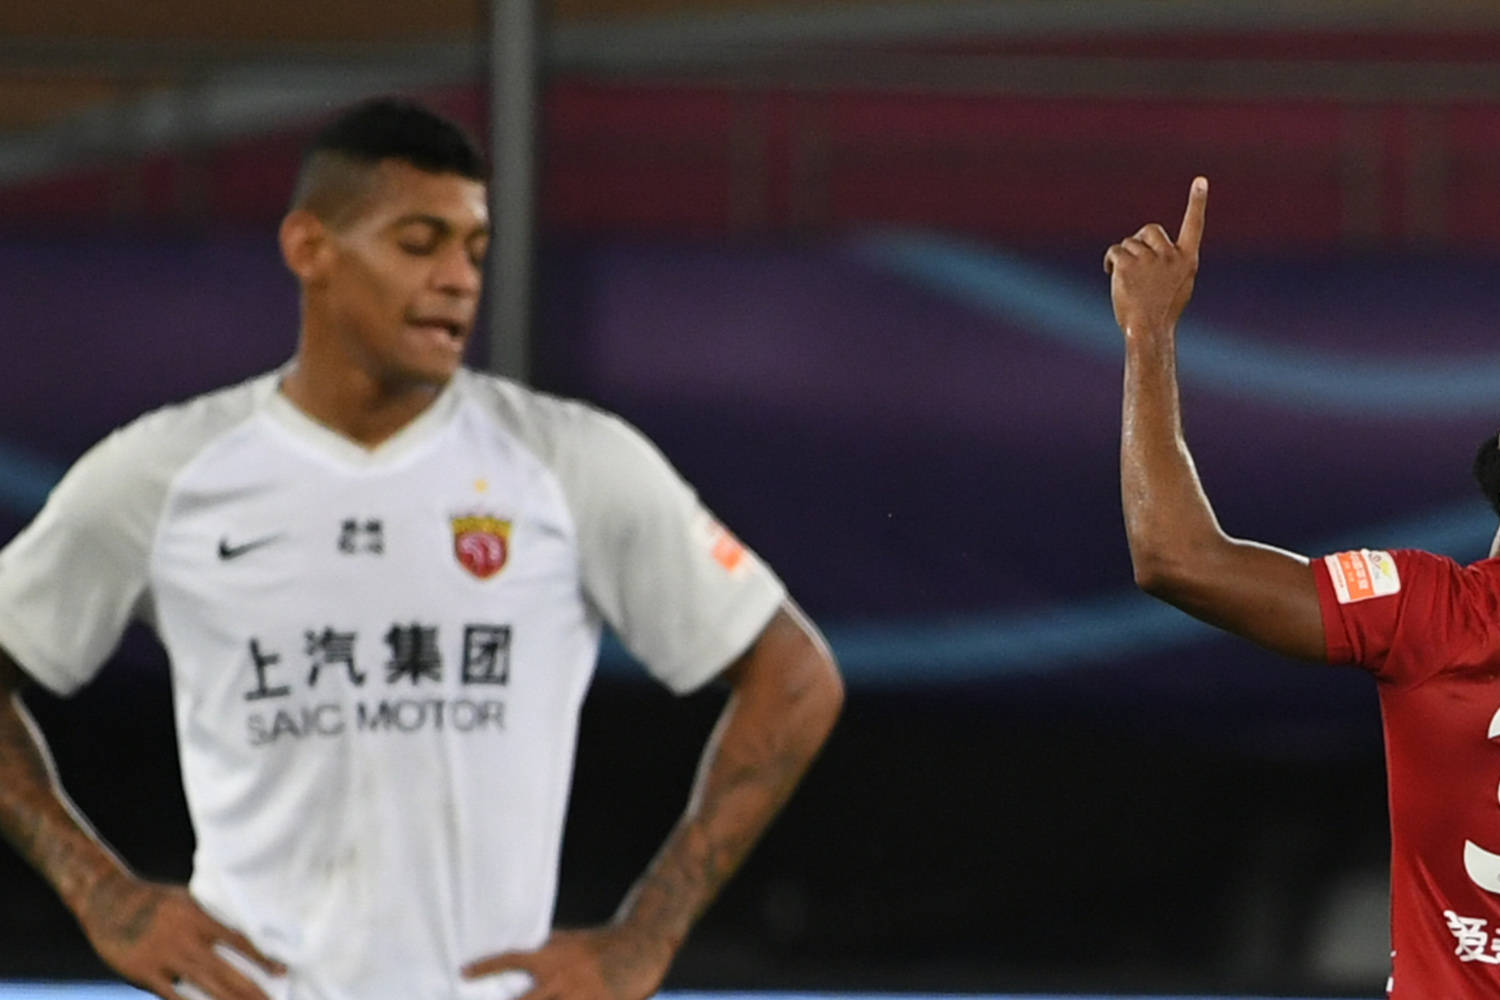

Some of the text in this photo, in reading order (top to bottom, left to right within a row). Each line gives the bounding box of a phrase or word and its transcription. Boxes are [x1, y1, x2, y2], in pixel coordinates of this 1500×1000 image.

[243, 621, 512, 701] 上汽集团
[247, 699, 506, 746] SAIC MOTOR
